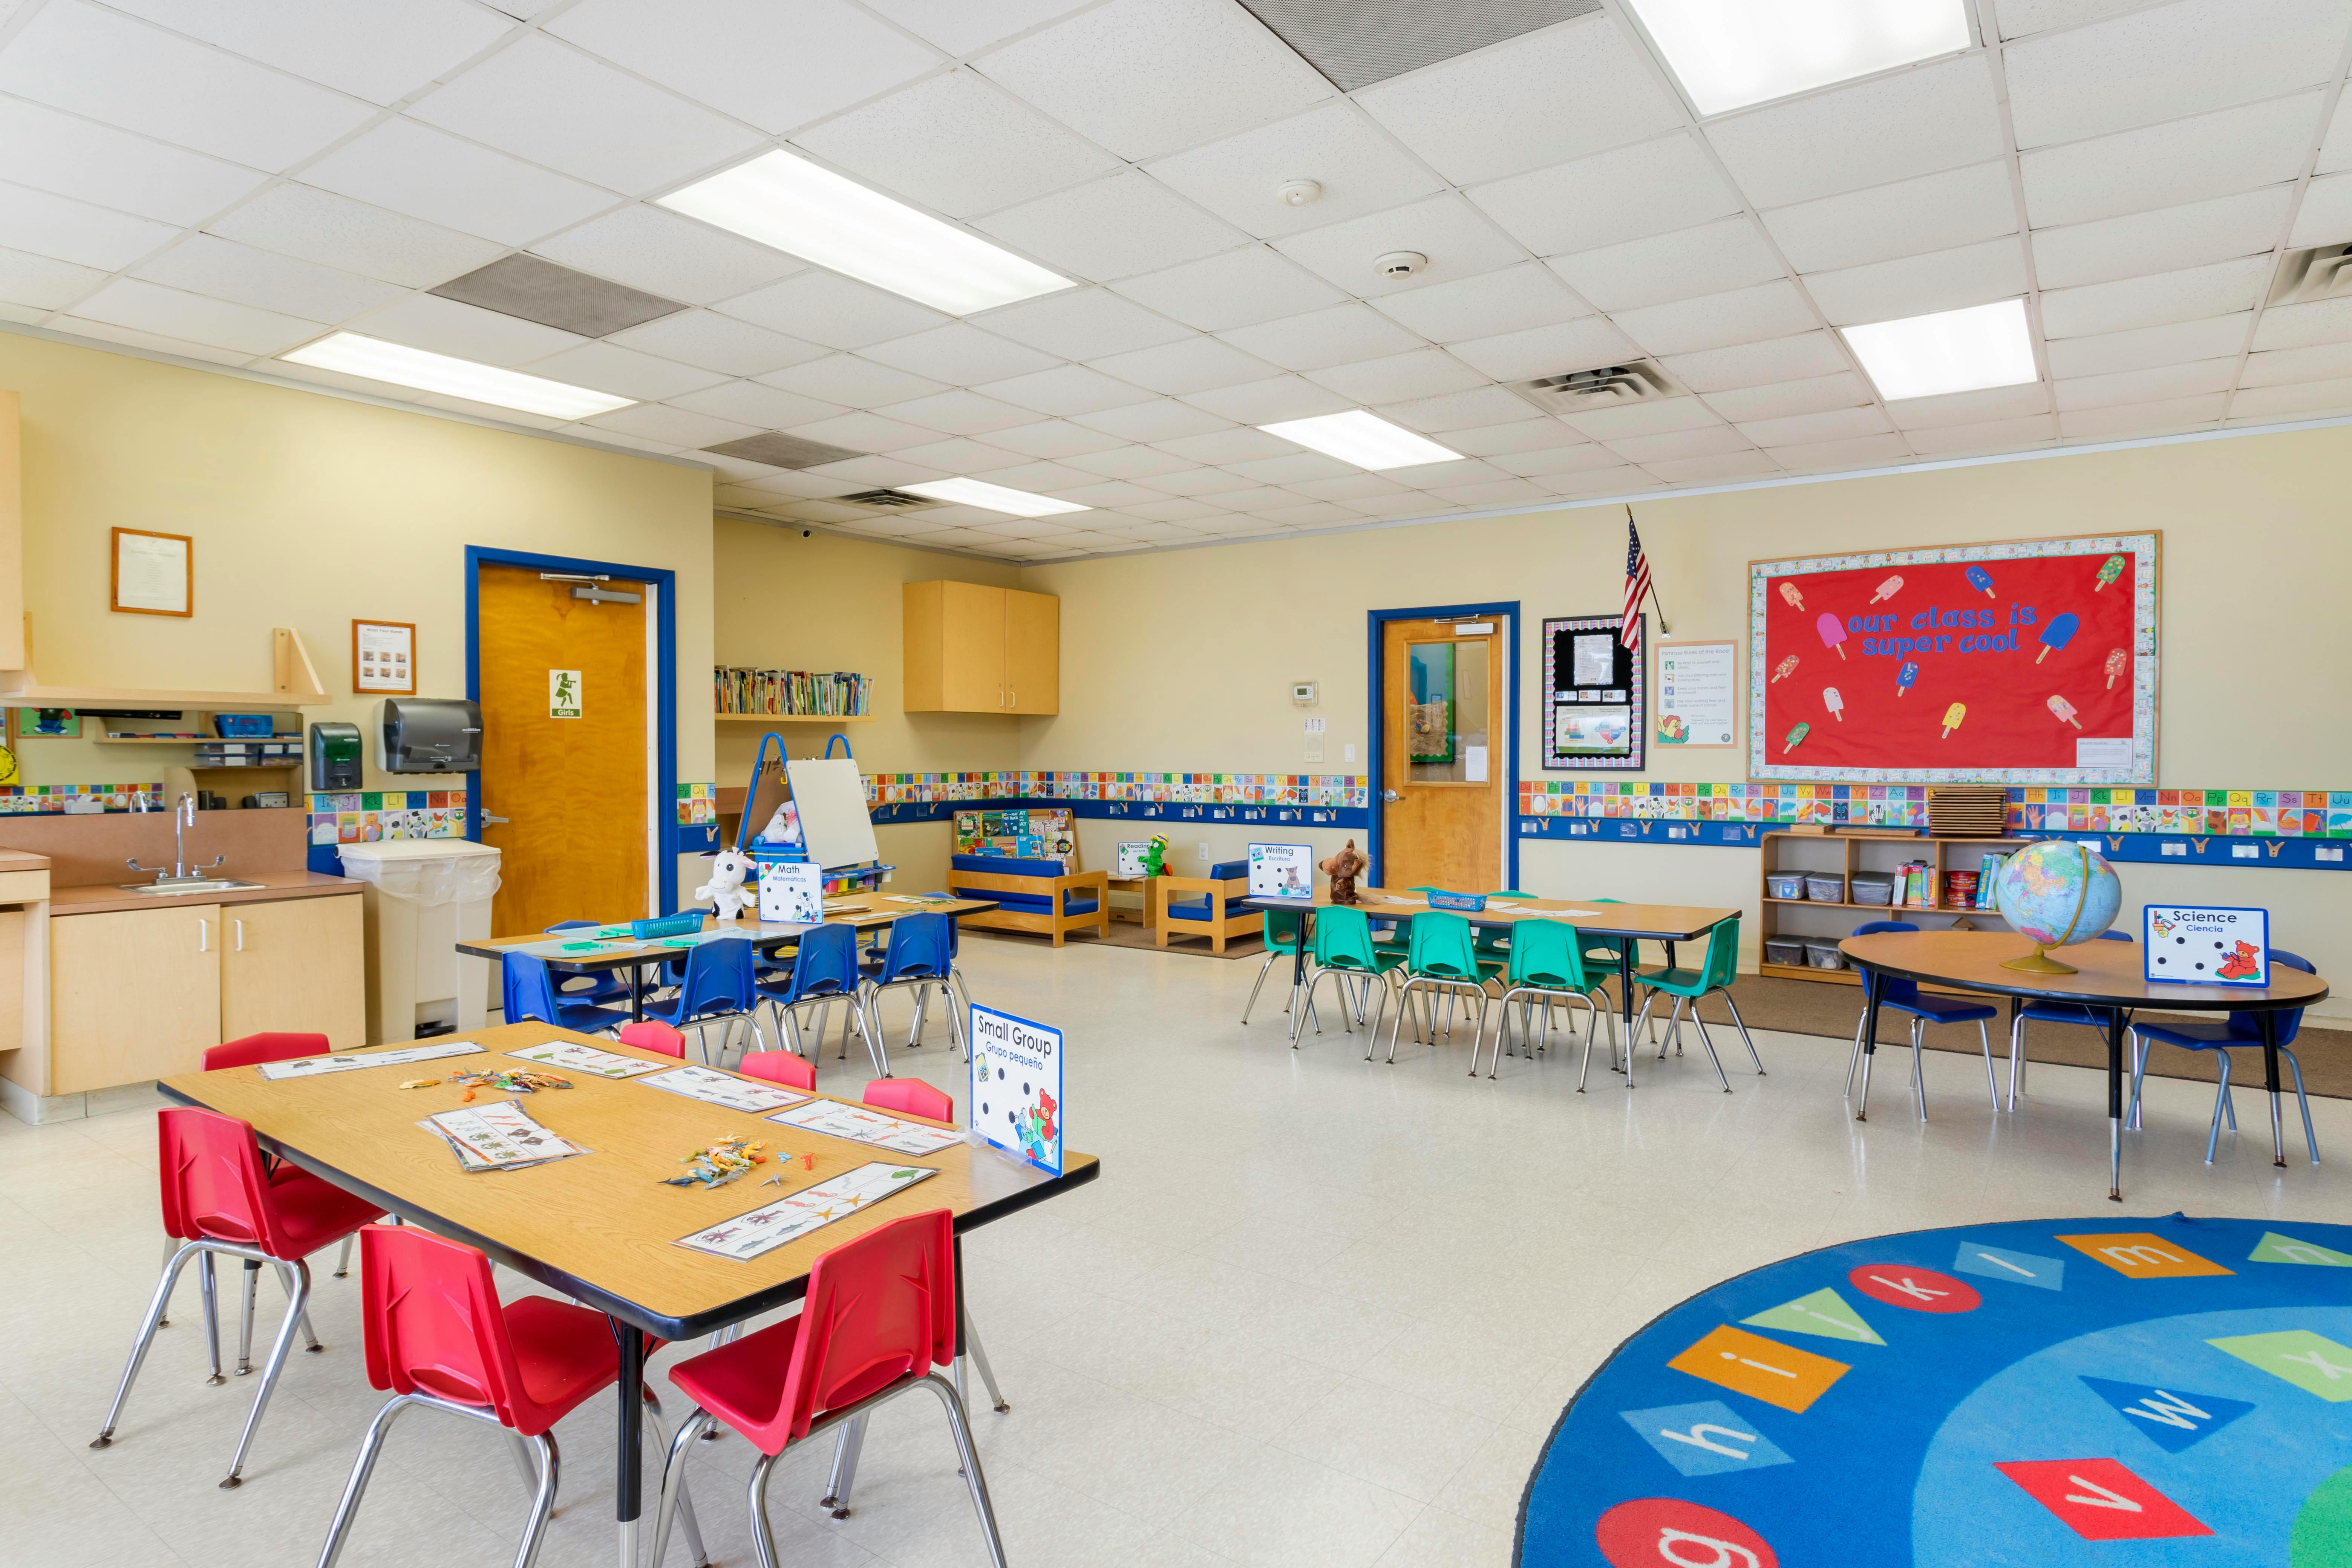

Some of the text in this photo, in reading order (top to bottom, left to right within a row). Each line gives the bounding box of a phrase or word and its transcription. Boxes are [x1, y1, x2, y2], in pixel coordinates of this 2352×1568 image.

[1848, 603, 2037, 633] our class is
[1862, 628, 2021, 661] super cool
[365, 796, 379, 805] Kk
[388, 795, 399, 805] Ll
[407, 794, 426, 804] Mm
[431, 794, 445, 803] Nn
[451, 793, 466, 803] Oo
[678, 786, 706, 798] Pp Qq
[1562, 784, 1573, 793] Gg
[1606, 784, 1615, 795] Jj
[1699, 786, 1709, 796] Pp
[1713, 786, 1728, 796] Qq
[1749, 786, 1758, 794] Ss
[1766, 786, 1776, 795] Tt
[1782, 787, 1793, 795] Uu
[1800, 787, 1810, 795] Vv
[1815, 787, 1831, 795] Ww
[1853, 787, 1864, 799] Yy
[1872, 787, 1883, 796] Zz
[1889, 788, 1904, 796] Aa
[1909, 789, 1922, 797] Bb
[2029, 790, 2043, 799] Hh
[2053, 790, 2060, 799] Ii
[2072, 790, 2085, 803] Jj
[2093, 791, 2107, 800] Kk
[2116, 791, 2127, 800] Ll
[2135, 792, 2156, 801] Mm
[2160, 792, 2176, 801] Nn
[2183, 792, 2201, 801] Oo
[2207, 793, 2223, 805] Pp
[2230, 793, 2251, 807] Qq
[2257, 793, 2273, 803] Rr
[2282, 793, 2297, 803] Ss
[2308, 794, 2323, 804] Tt
[2332, 794, 2350, 804] Uu
[1265, 846, 1293, 856] Writing
[778, 865, 799, 874] Math
[1980, 870, 1989, 892] Matching
[2173, 911, 2237, 923] Science
[978, 1015, 1051, 1059] Small Group
[986, 1041, 1043, 1070] Grupo pequeño
[2097, 1245, 2184, 1266] m
[2271, 1245, 2338, 1264] n
[1869, 1275, 1949, 1301] k
[1790, 1304, 1871, 1340] j
[1720, 1352, 1797, 1378] i
[2279, 1351, 2352, 1380] x
[2123, 1390, 2213, 1430] w
[1661, 1423, 1757, 1460] h
[2065, 1475, 2142, 1512] v
[1657, 1526, 1761, 1568] g
